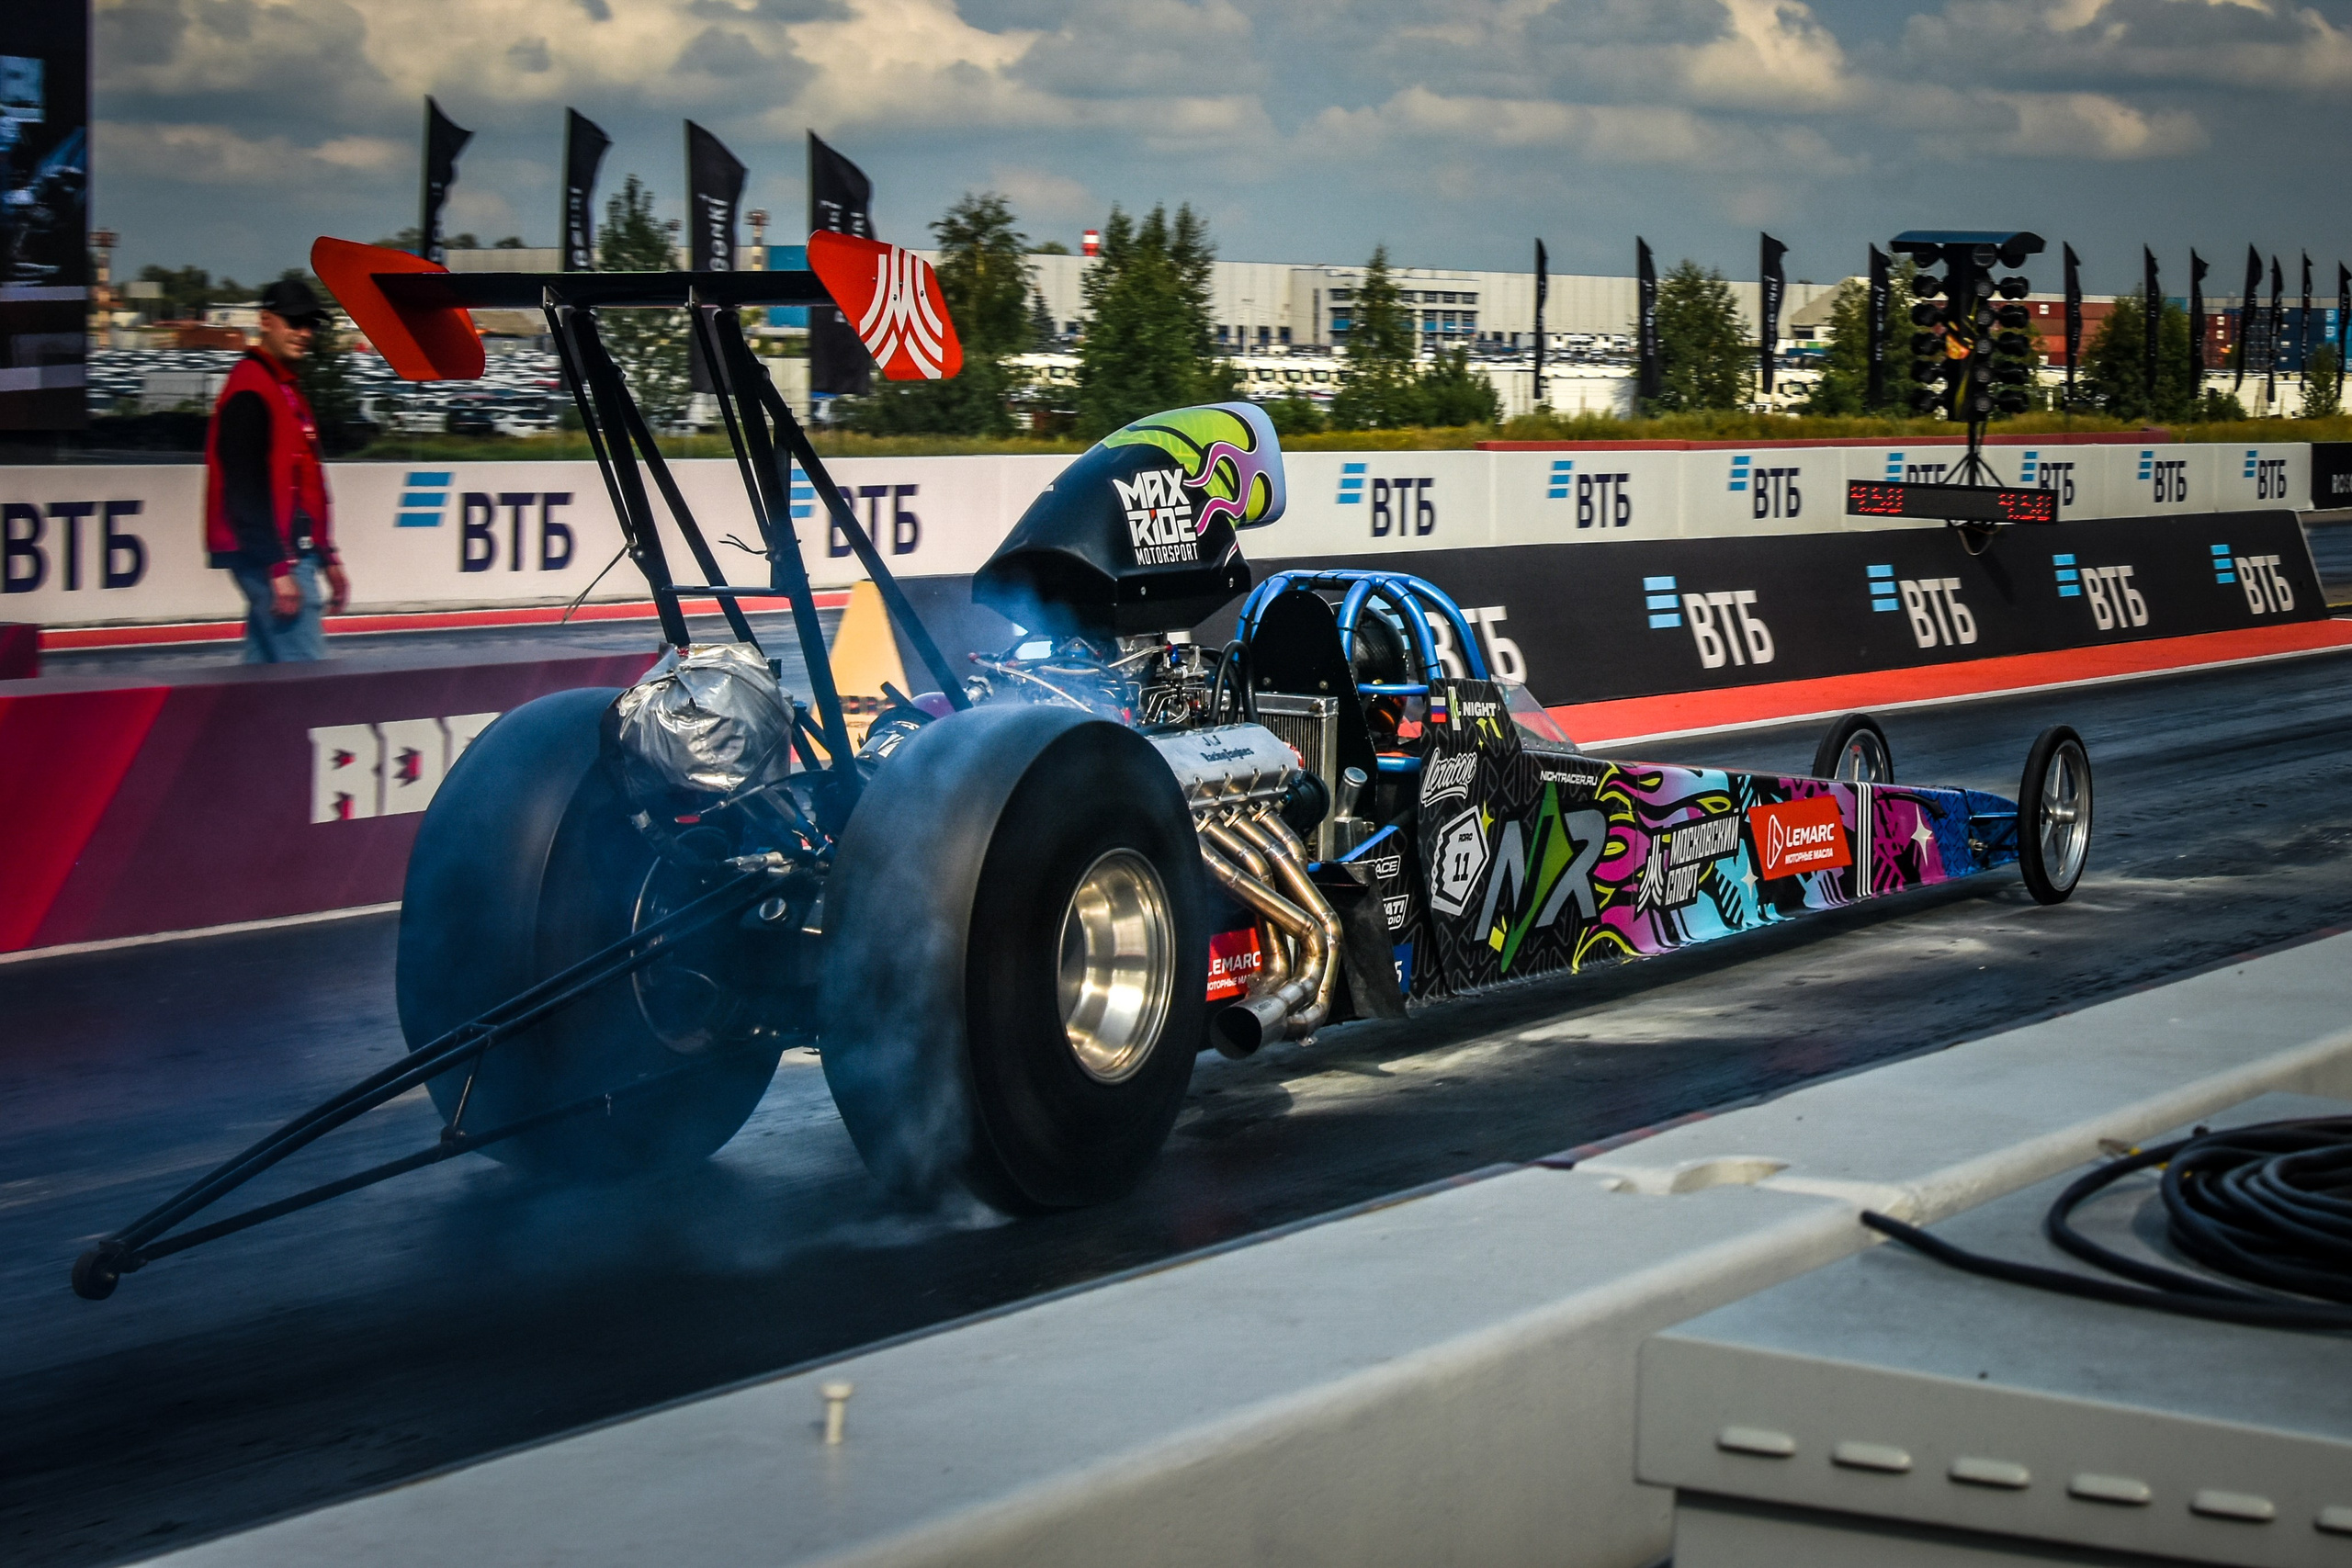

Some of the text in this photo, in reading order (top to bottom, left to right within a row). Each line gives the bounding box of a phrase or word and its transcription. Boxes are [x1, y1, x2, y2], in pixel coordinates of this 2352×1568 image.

[1112, 468, 1191, 511] MAX
[1753, 468, 1801, 519] ВТБ
[2154, 460, 2187, 502] ВТБ
[2257, 459, 2287, 499] ВТБ
[1372, 478, 1435, 537] ВТБ
[1577, 473, 1631, 529] ВТБ
[1, 501, 149, 593] ВТБ
[458, 491, 577, 572] ВТБ
[1135, 543, 1198, 566] MOTORSPORT
[2081, 565, 2149, 631] ВТБ
[2234, 555, 2295, 615] ВТБ
[1681, 590, 1775, 670] ВТБ
[1899, 578, 1978, 649] ВТБ
[1463, 701, 1497, 716] NIGHT
[1540, 770, 1598, 786] NIGHTRACER.RU
[1669, 808, 1739, 867] МОСКОВСКИЙ
[1785, 823, 1835, 848] LEMARC
[1375, 860, 1398, 874] ACE
[1452, 852, 1470, 882] 11
[1665, 863, 1701, 906] СПОРТ
[1384, 899, 1406, 916] ATI
